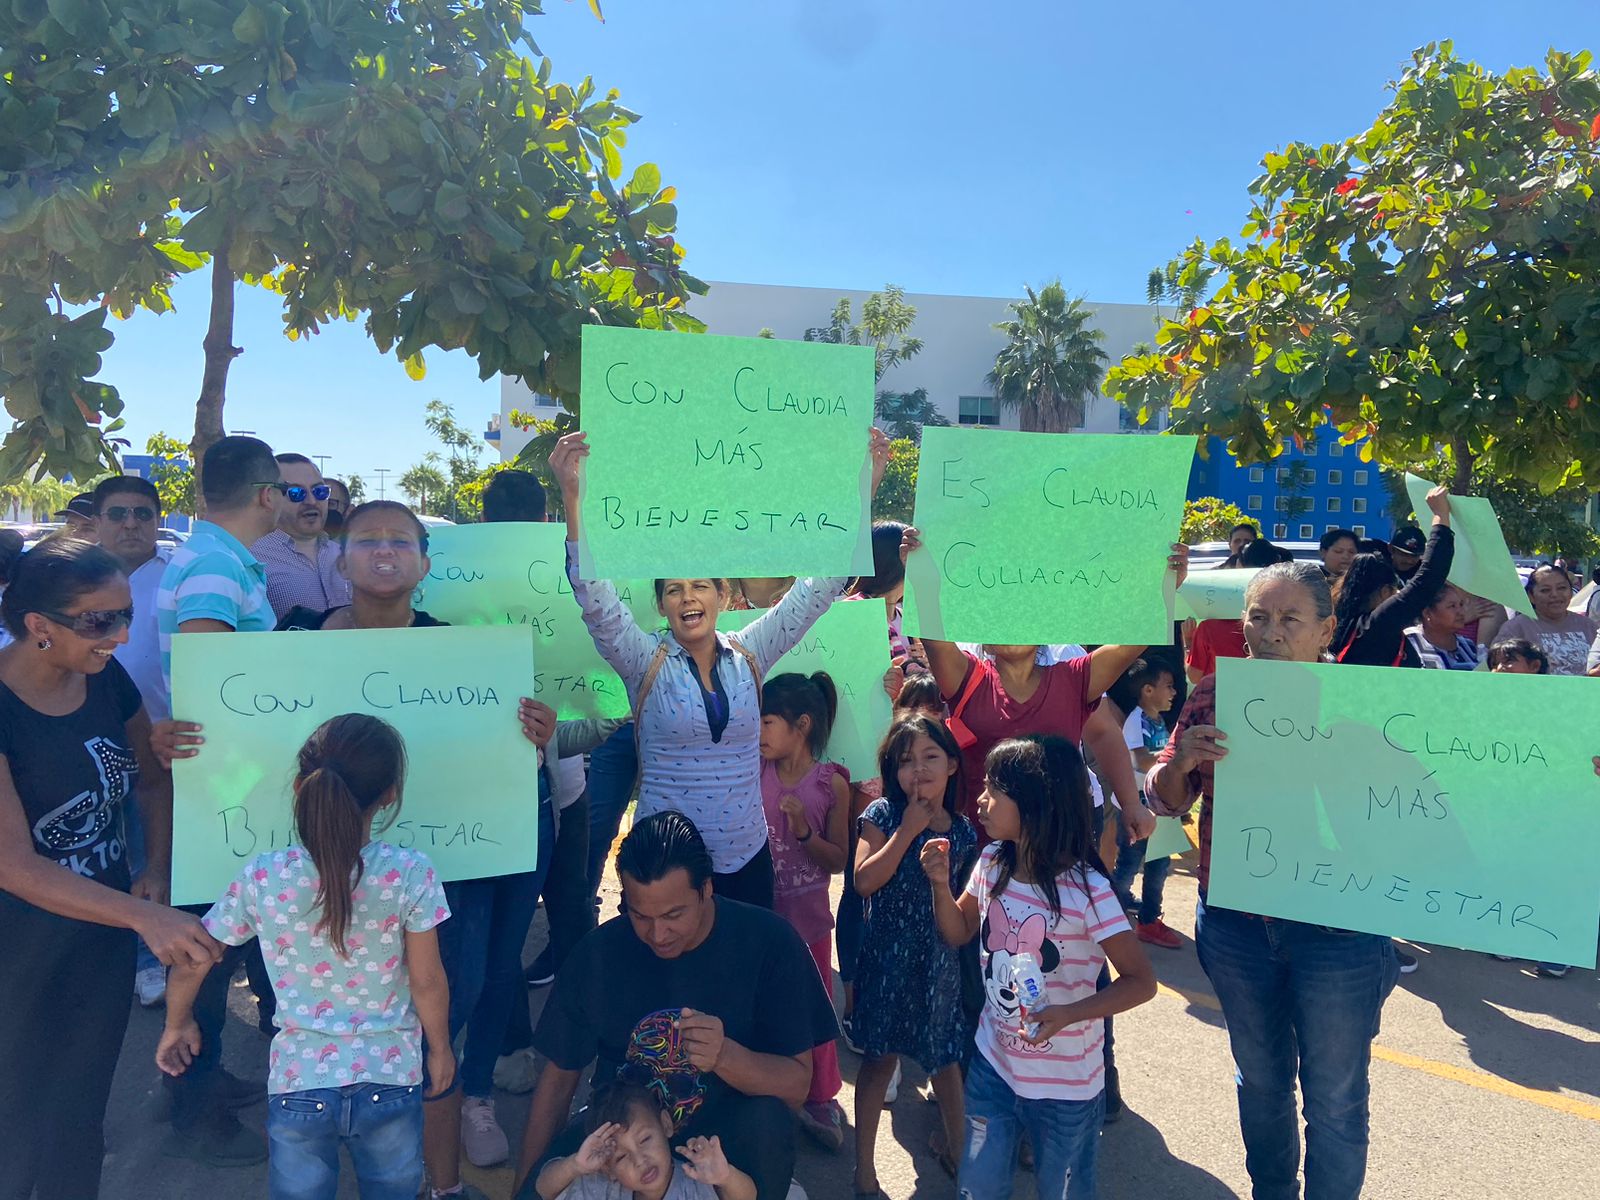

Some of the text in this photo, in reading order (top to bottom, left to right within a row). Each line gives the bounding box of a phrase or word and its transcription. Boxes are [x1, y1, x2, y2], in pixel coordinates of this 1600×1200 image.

[694, 426, 763, 470] MÁS
[601, 496, 847, 532] BIENESTAR
[1368, 770, 1450, 820] MÁS
[1240, 825, 1559, 941] BIENESTAR
